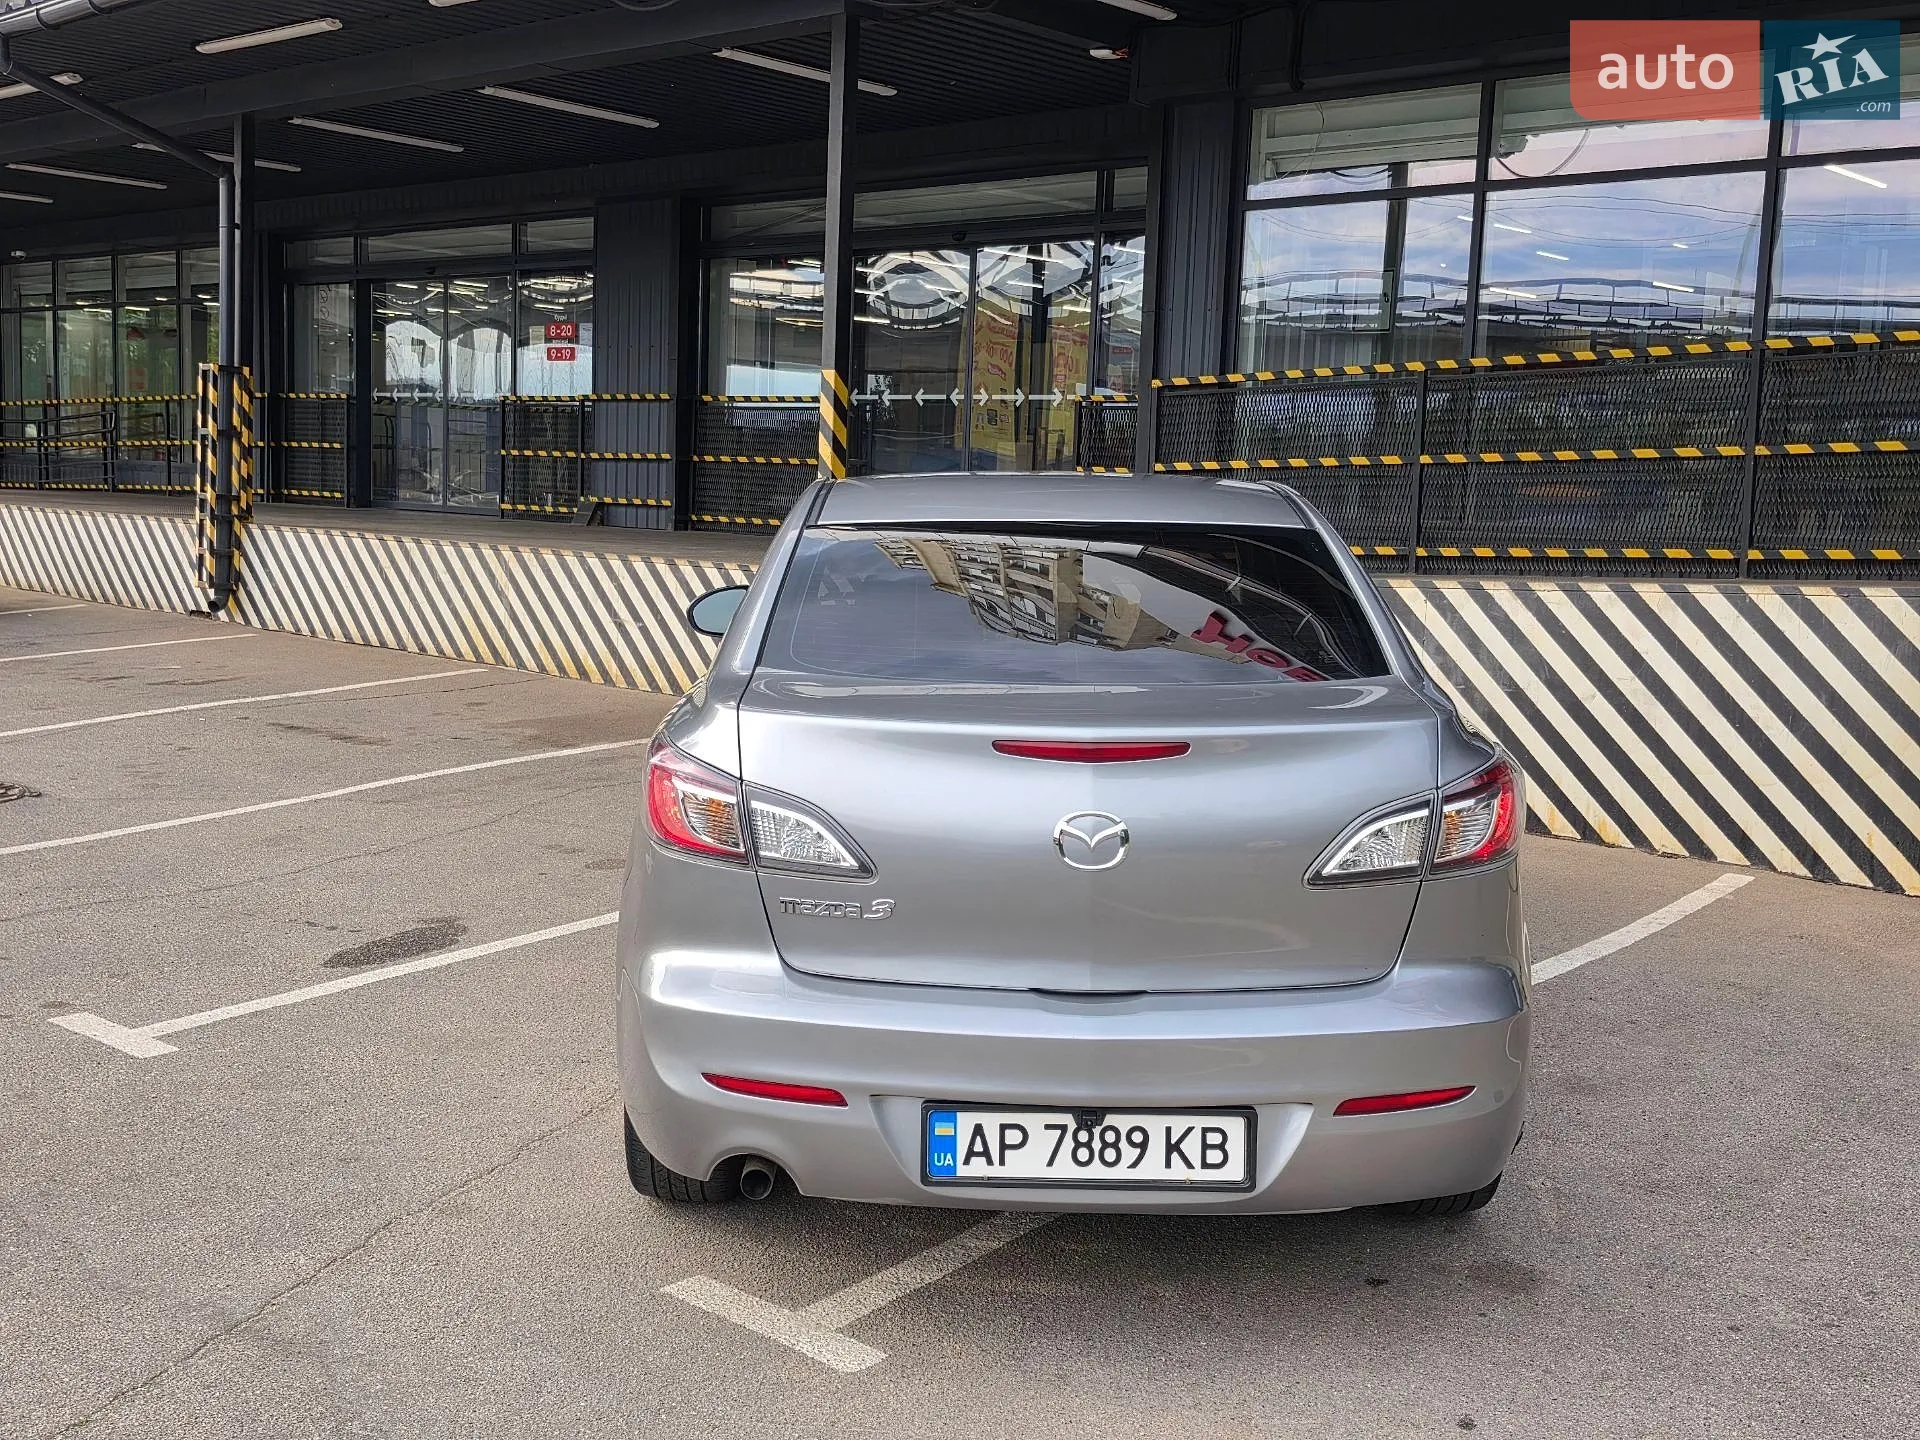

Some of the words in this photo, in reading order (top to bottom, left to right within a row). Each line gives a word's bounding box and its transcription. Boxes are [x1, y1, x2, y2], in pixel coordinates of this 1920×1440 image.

[550, 325, 573, 337] 8-20
[550, 348, 572, 360] 9-19
[962, 1122, 1030, 1167] AP
[1043, 1123, 1150, 1169] 7889
[1164, 1125, 1229, 1170] KB
[934, 1152, 955, 1168] UA
